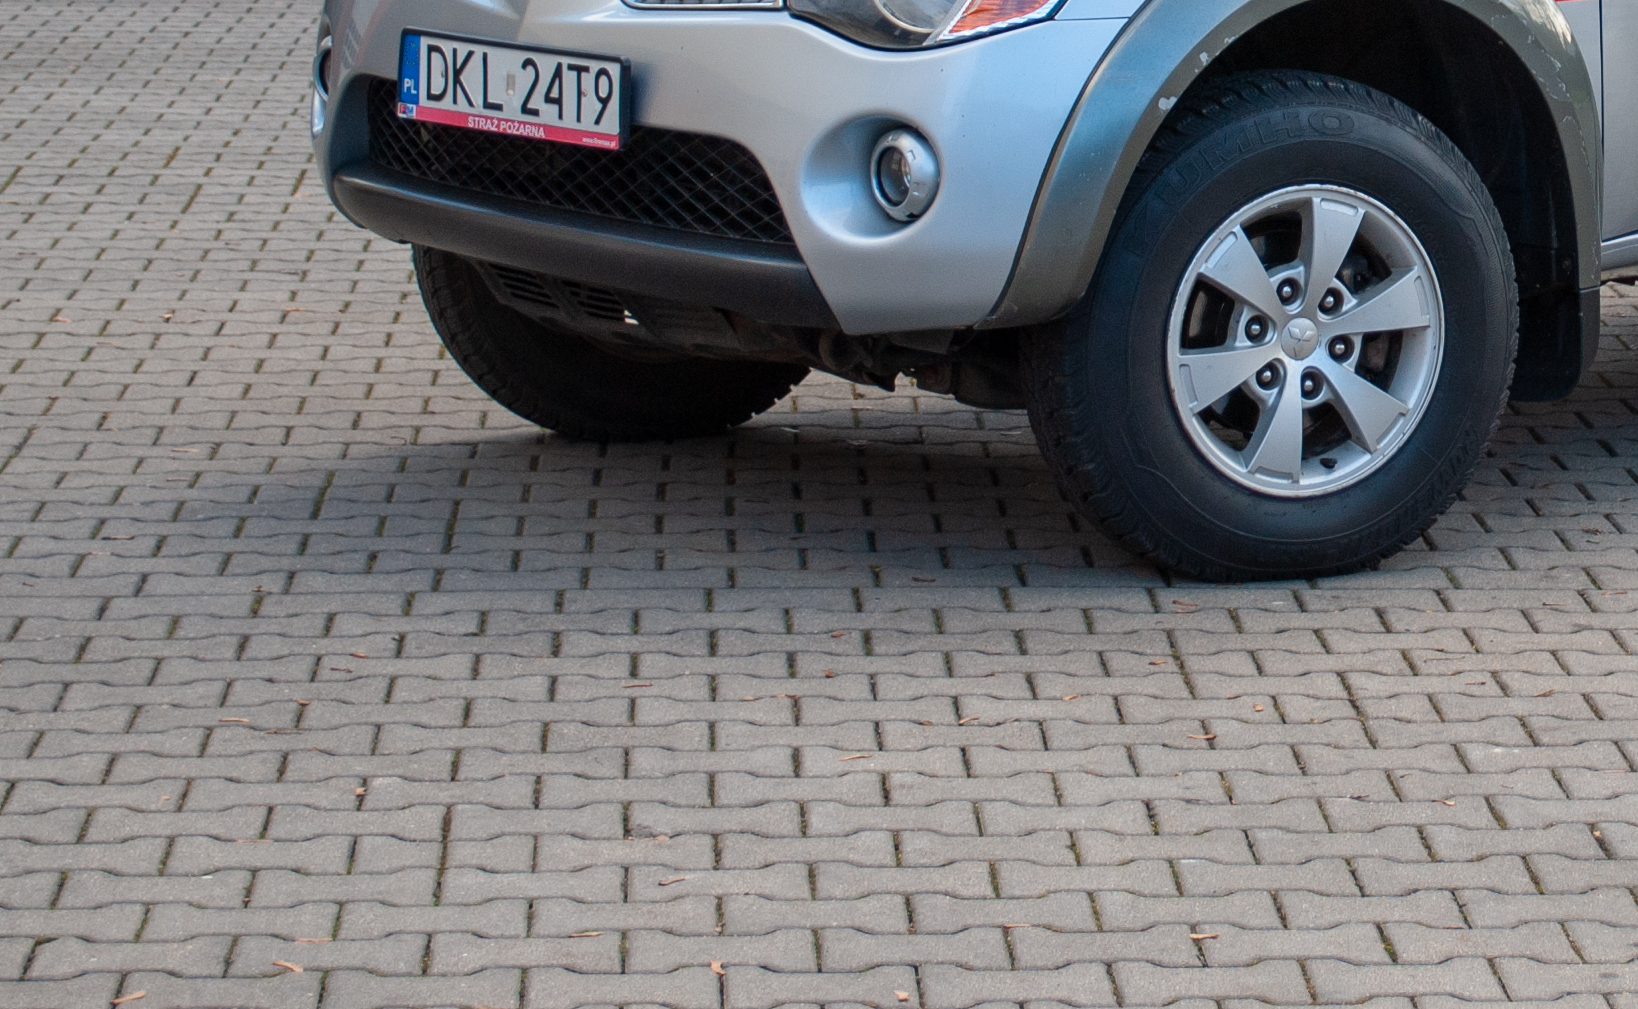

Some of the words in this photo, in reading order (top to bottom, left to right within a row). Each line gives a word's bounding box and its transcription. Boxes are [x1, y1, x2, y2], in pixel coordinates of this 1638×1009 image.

[403, 78, 418, 95] PL
[426, 43, 504, 113] DKL
[520, 57, 614, 126] 24T9
[467, 116, 498, 131] STRAŻ
[500, 120, 545, 138] POŻARNA
[1121, 110, 1355, 257] KUMHO
